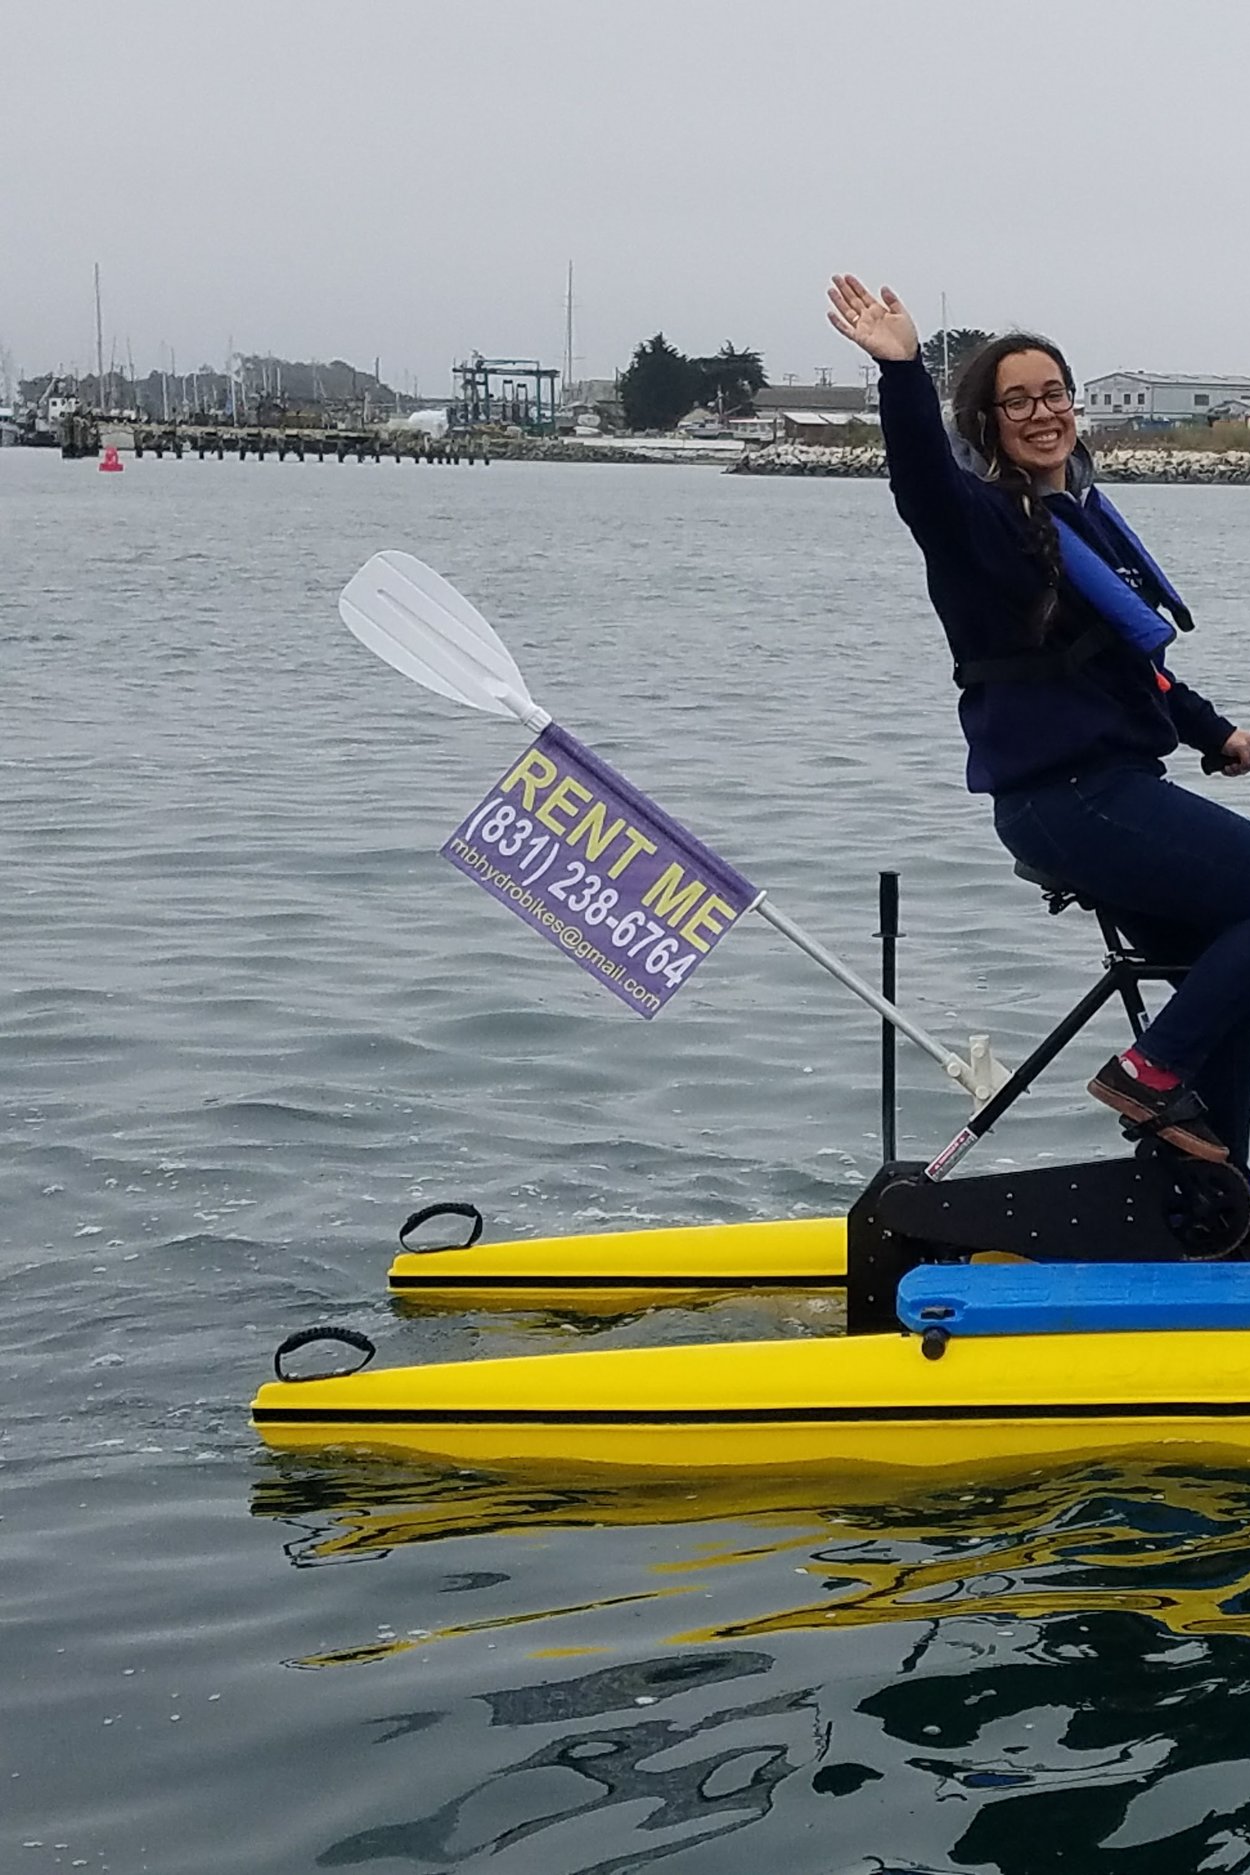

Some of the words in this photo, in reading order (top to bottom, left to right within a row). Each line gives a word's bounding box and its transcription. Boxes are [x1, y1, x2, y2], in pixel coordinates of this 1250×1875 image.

[449, 837, 661, 1012] mbhydrobikes@gmail.com
[465, 797, 560, 887] (831)
[548, 861, 697, 989] 238-6764
[500, 748, 658, 880] RENT
[641, 862, 738, 954] ME
